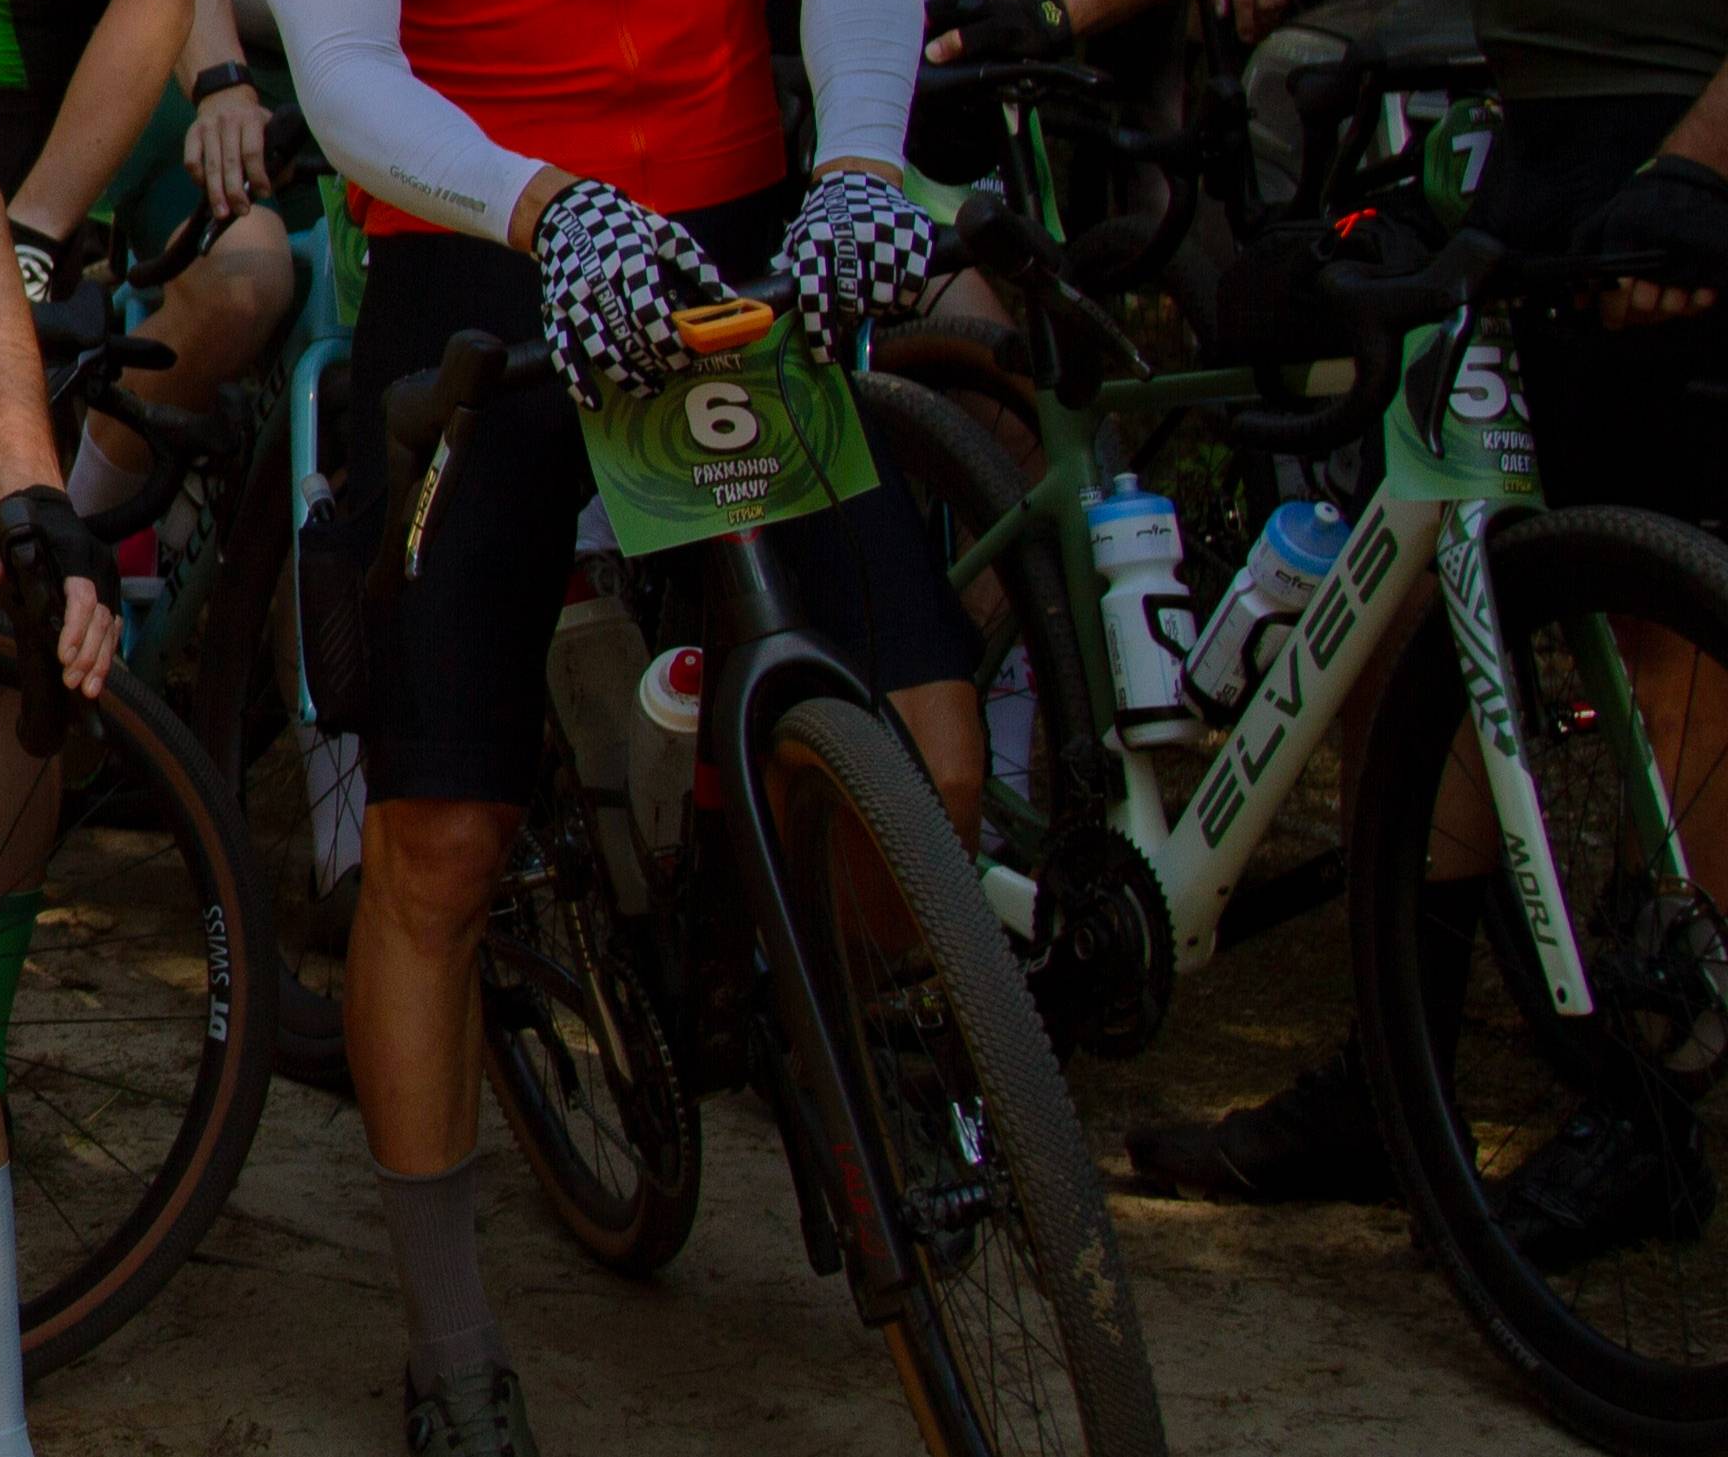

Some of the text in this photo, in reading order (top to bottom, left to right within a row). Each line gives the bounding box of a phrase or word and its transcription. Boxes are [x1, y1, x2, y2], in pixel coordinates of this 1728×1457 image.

[683, 381, 761, 450] 6
[692, 456, 781, 486] РАХМАНОВ
[712, 478, 769, 506] ТИМУР
[206, 903, 232, 1043] DT SWISS
